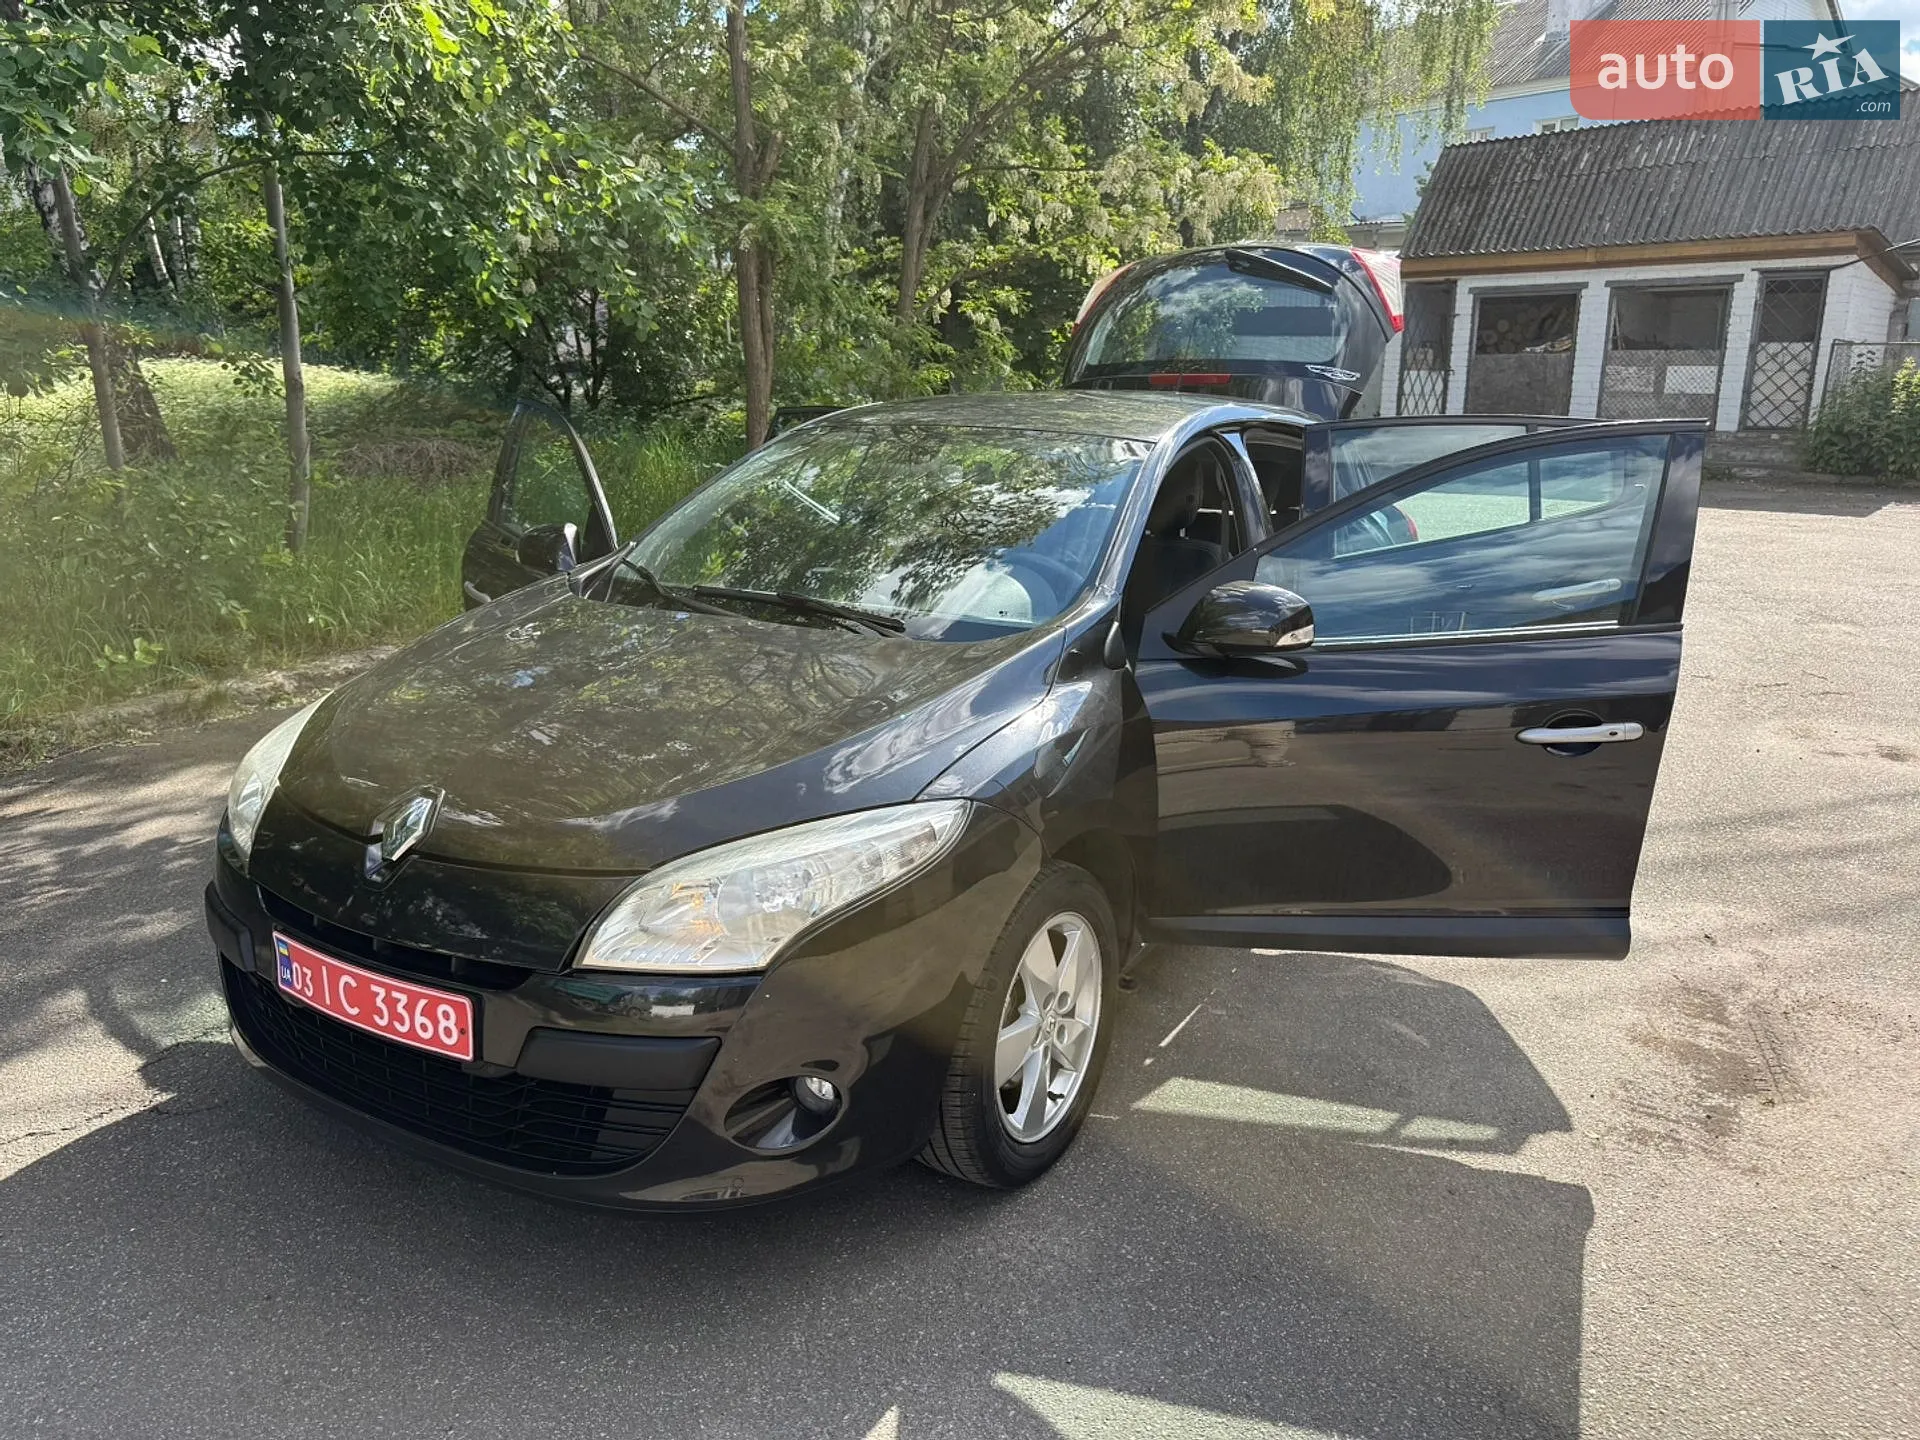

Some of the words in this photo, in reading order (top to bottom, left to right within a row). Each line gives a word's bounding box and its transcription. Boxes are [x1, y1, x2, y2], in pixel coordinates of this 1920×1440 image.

[281, 965, 292, 982] UA
[292, 962, 314, 997] 03
[370, 984, 459, 1046] 3368
